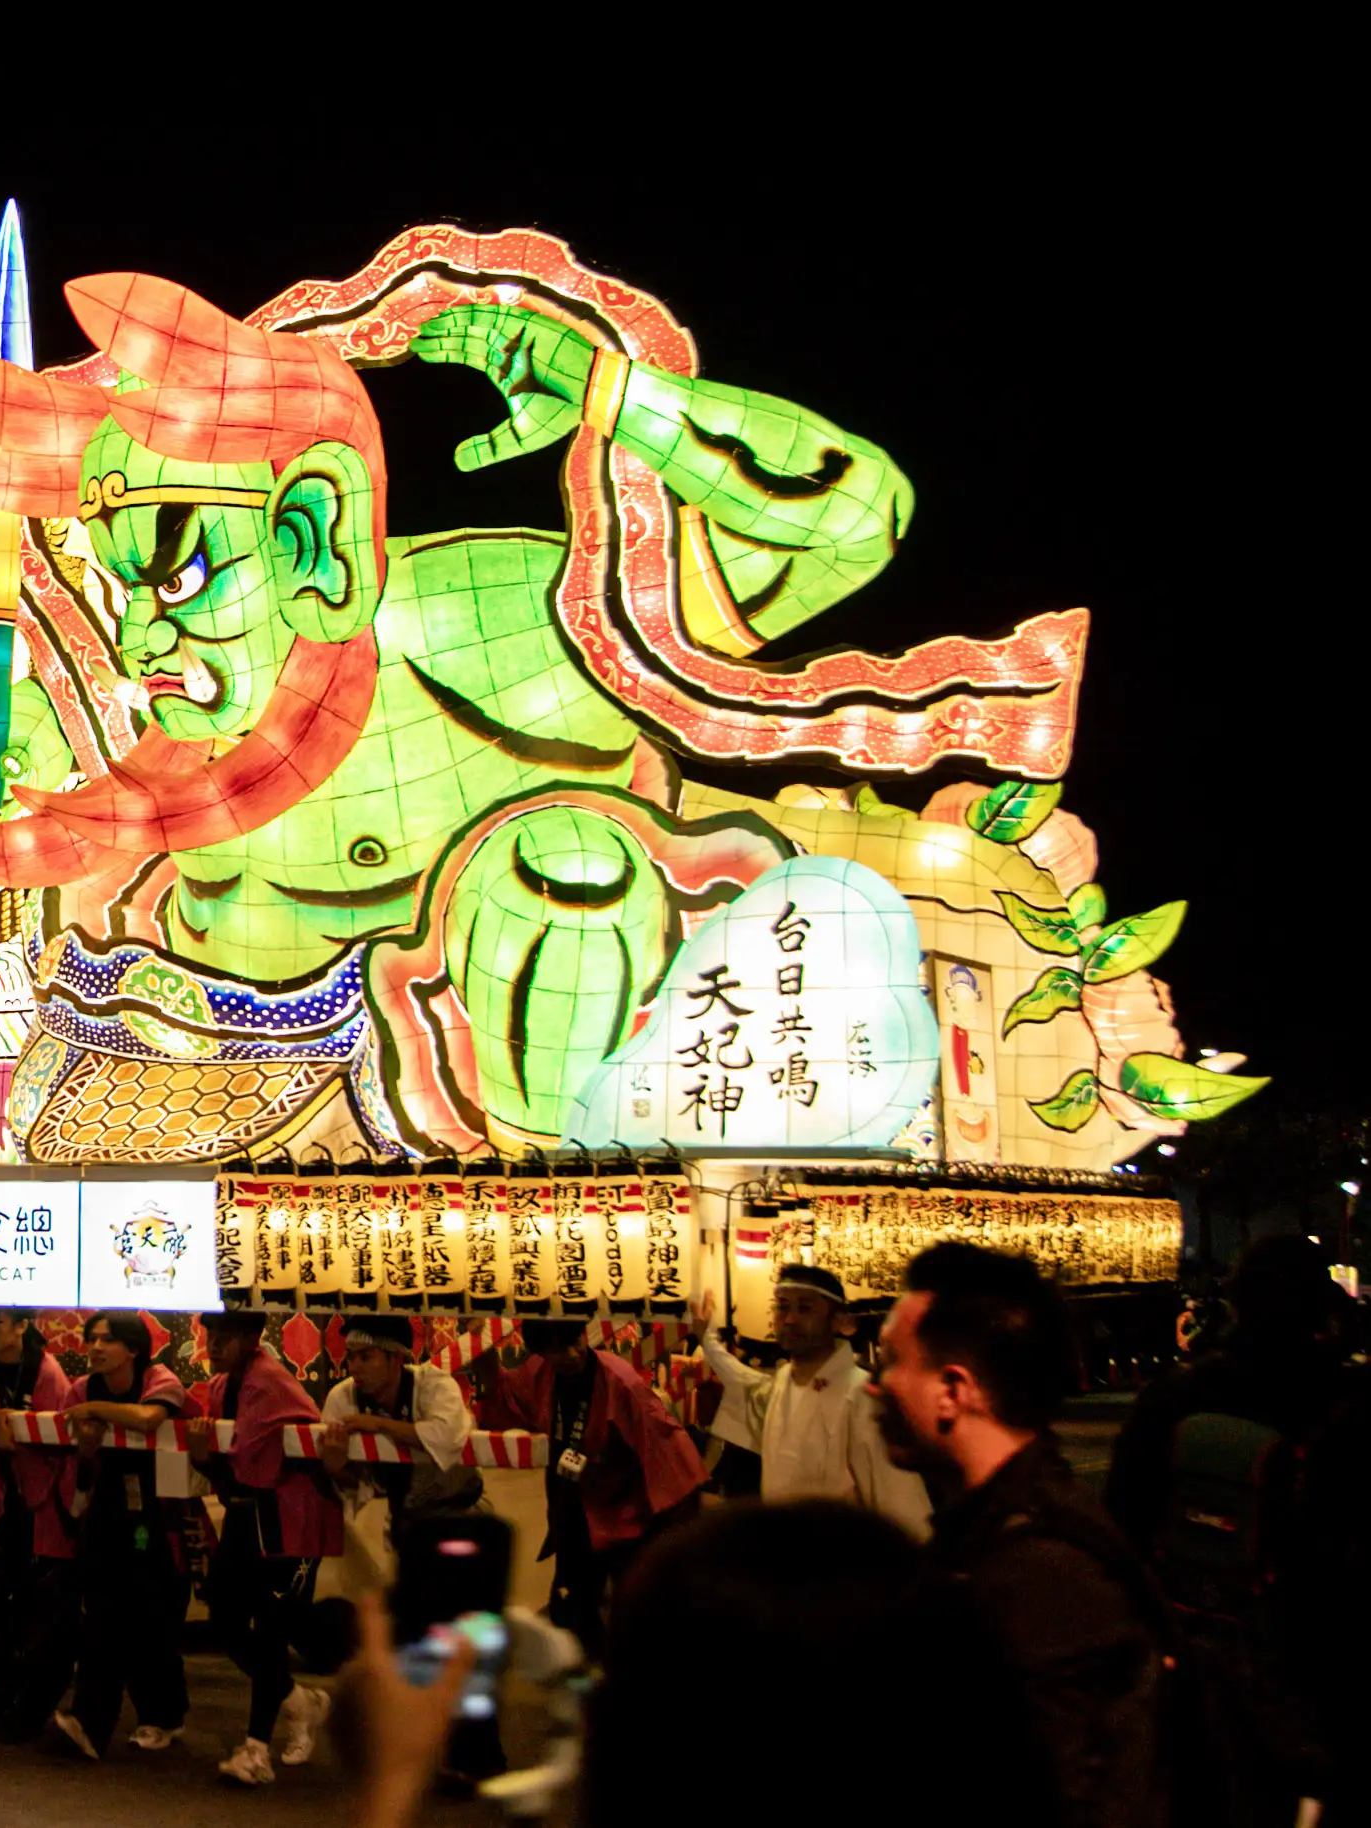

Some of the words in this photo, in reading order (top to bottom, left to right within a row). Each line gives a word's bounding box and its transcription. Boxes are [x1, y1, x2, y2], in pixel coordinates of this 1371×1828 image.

[675, 964, 756, 1140] 天妃神
[767, 900, 819, 1108] 台日共鳴
[348, 1183, 375, 1289] 配天宮董事
[643, 1179, 682, 1298] 寶島神很大
